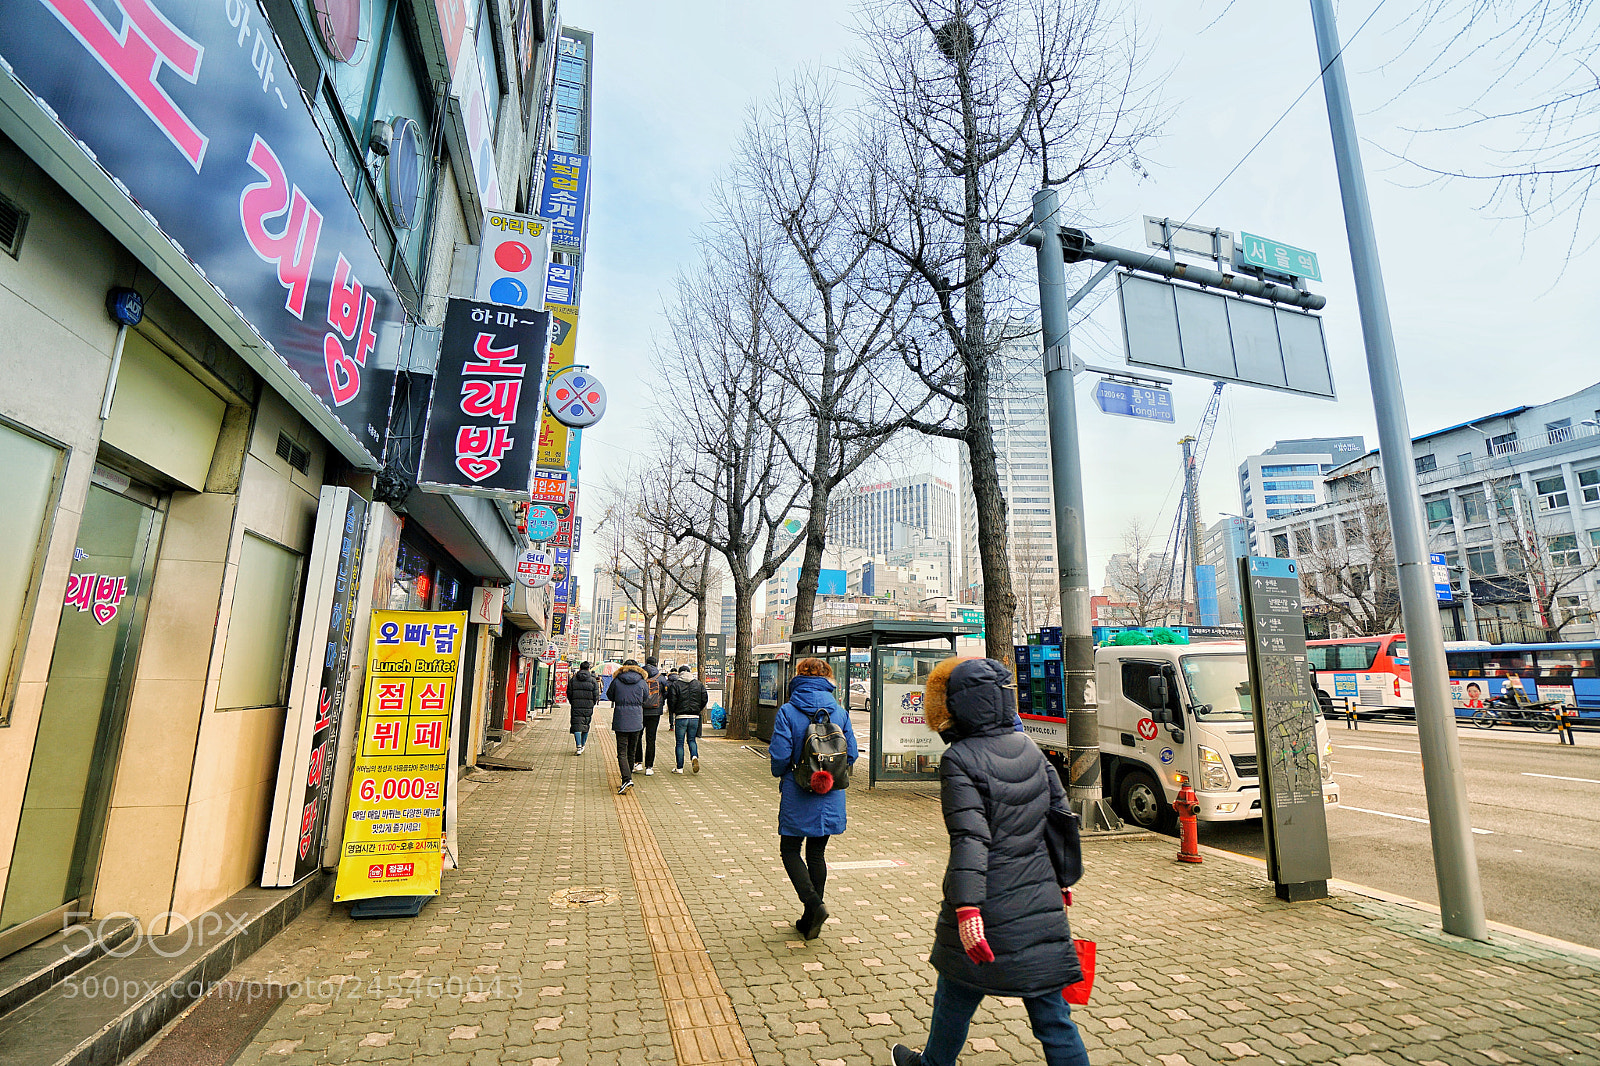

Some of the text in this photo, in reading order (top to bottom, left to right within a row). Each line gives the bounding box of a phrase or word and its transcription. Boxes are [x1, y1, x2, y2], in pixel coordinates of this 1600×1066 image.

[552, 153, 582, 167] 제일
[547, 163, 580, 230] 직업소개소
[490, 216, 545, 238] 아리랑
[1250, 241, 1315, 276] 서울역
[126, 299, 142, 317] ADT
[471, 308, 535, 328] 하마~
[1100, 389, 1116, 399] 1200
[1131, 388, 1169, 406] 통일로
[455, 331, 527, 482] 노래방
[1129, 404, 1171, 419] Tongil-ro
[532, 508, 547, 518] 2F
[526, 552, 545, 563] 현대
[519, 562, 549, 575] 부동산
[376, 622, 459, 654] 오빠닭
[372, 659, 456, 673] Lunch Buffet
[298, 686, 332, 861] 노래방
[360, 777, 441, 803] 6,000원
[352, 808, 441, 820] 매일 매일 바뀌는 다양한 메뉴로
[371, 822, 421, 834] 맛있게 즐기세요!
[347, 843, 376, 854] 영업시간
[415, 841, 439, 851] 2시까지
